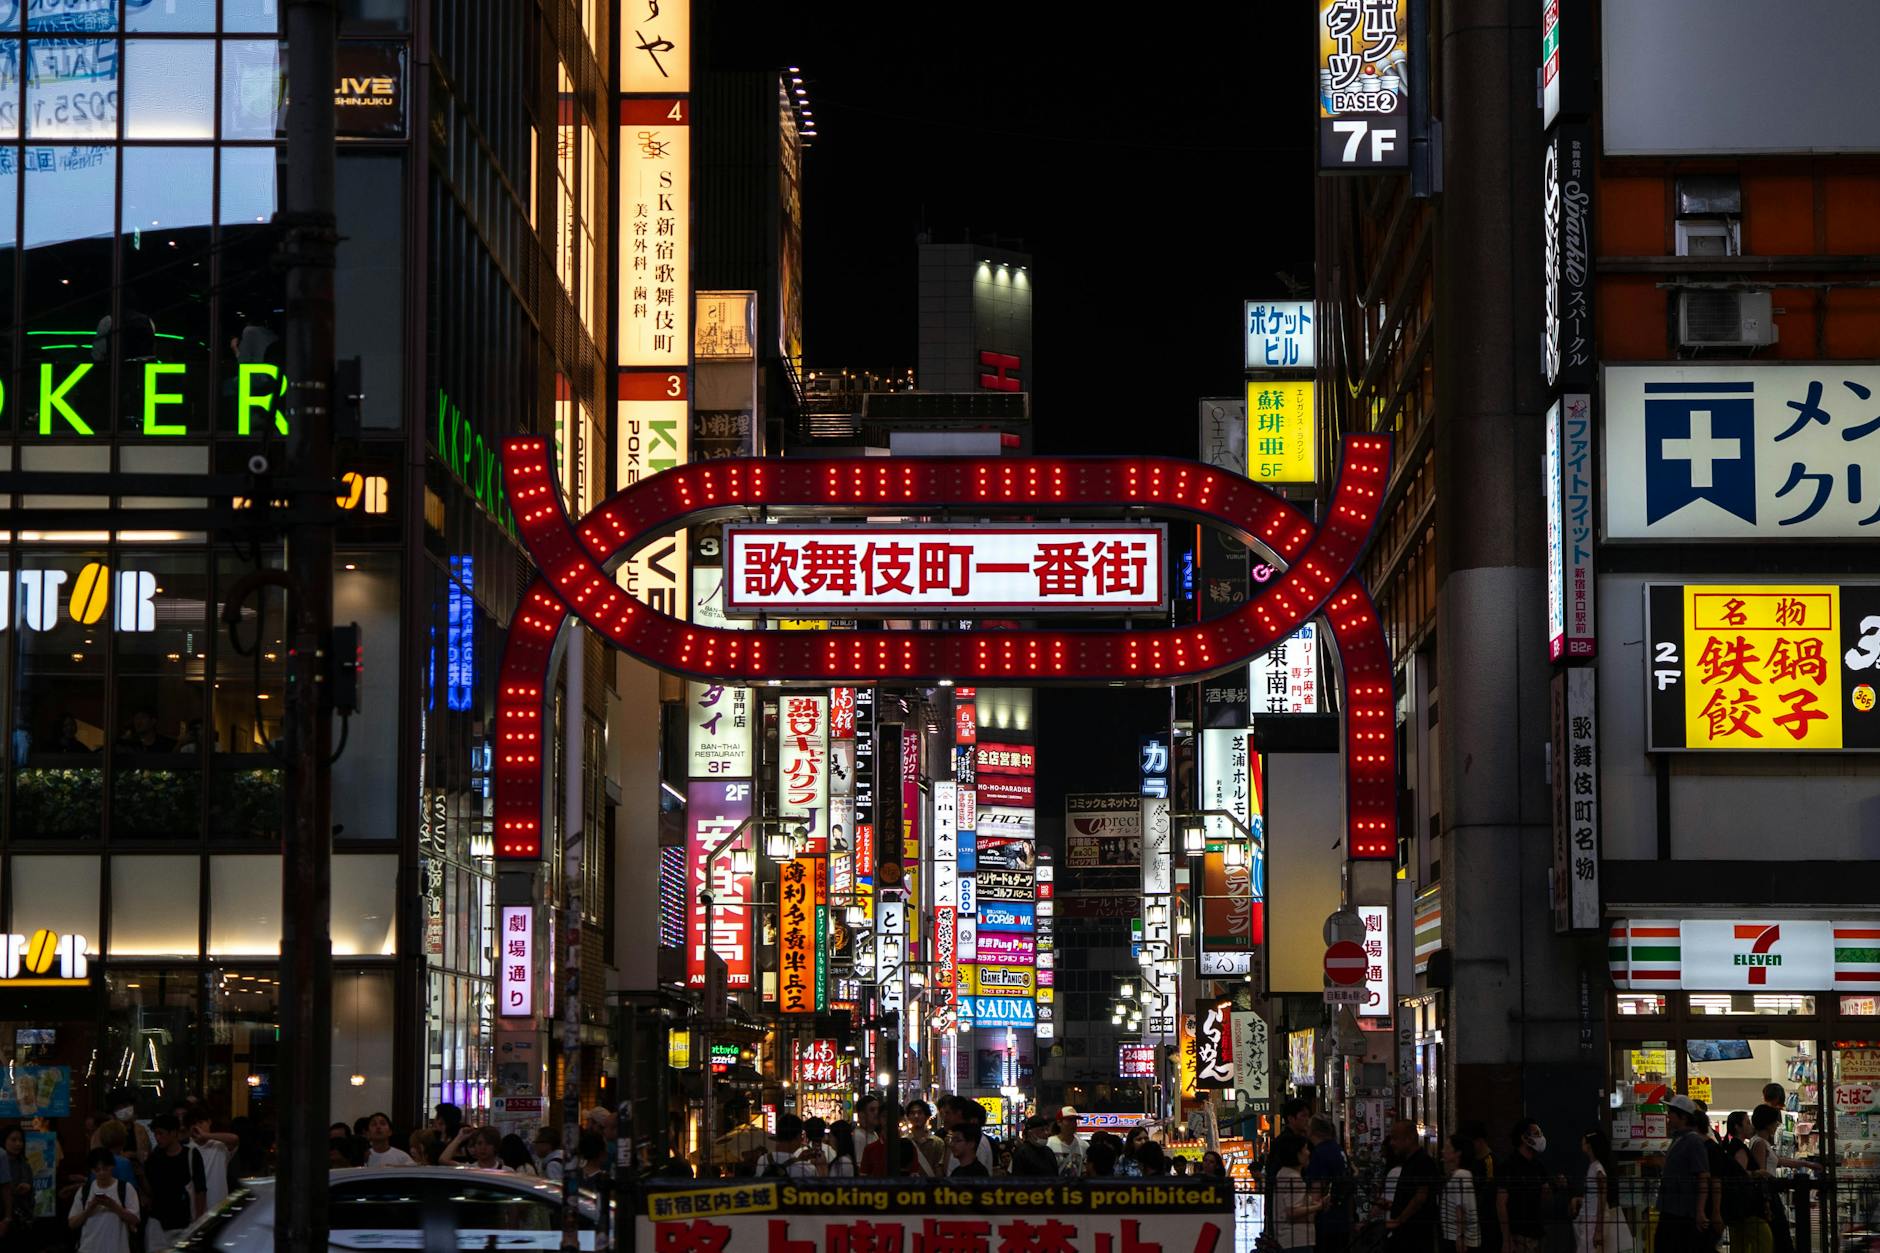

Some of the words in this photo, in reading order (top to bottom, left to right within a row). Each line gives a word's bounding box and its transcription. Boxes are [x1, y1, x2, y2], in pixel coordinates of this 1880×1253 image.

[335, 78, 393, 95] IVE
[667, 101, 682, 121] 4
[1333, 121, 1397, 162] 7F
[1572, 141, 1582, 178] 歌舞伎町
[1564, 180, 1589, 288] Sparkle
[632, 203, 648, 319] 美容外科・歯科
[653, 170, 676, 354] SK新宿歌舞伎町
[1250, 305, 1311, 335] ポケット
[1567, 291, 1588, 368] スパークル
[1265, 337, 1299, 366] ビル
[0, 363, 289, 436] KER
[666, 375, 681, 397] 3
[1260, 463, 1283, 477] 5F
[1567, 420, 1590, 564] ファイトフィット
[700, 537, 719, 556] 3
[744, 541, 1147, 597] 歌舞伎町一番街
[1574, 568, 1586, 633] 新宿東口駅前
[1719, 598, 1807, 627] 名物
[1570, 644, 1592, 653] B2F
[1697, 636, 1829, 686] 鉄鍋
[1302, 642, 1314, 705] リーチ麻雀
[1654, 642, 1682, 690] 2F
[1291, 667, 1302, 713] 専門店
[1697, 688, 1829, 741] 餃子
[708, 761, 731, 773] 3F
[977, 752, 1032, 768] 全店営業中
[725, 784, 750, 801] 2F
[1571, 717, 1594, 881] 歌舞伎町名物
[978, 813, 1033, 824] FACE
[961, 880, 971, 911] GiGO
[508, 914, 527, 1007] 劇場通り
[1364, 914, 1383, 1007] 劇場通り
[1734, 925, 1780, 984] 7
[981, 968, 1000, 983] GAME
[1001, 969, 1022, 985] PANIC
[976, 999, 1035, 1018] SAUNA
[1836, 1088, 1873, 1105] たばこ
[653, 1187, 771, 1214] 新宿区内全域
[782, 1187, 889, 1209] Smoking
[896, 1191, 926, 1205] on
[933, 1187, 974, 1205] the
[979, 1187, 1054, 1205] street
[1061, 1187, 1084, 1205] is
[1090, 1187, 1223, 1209] prohibited.
